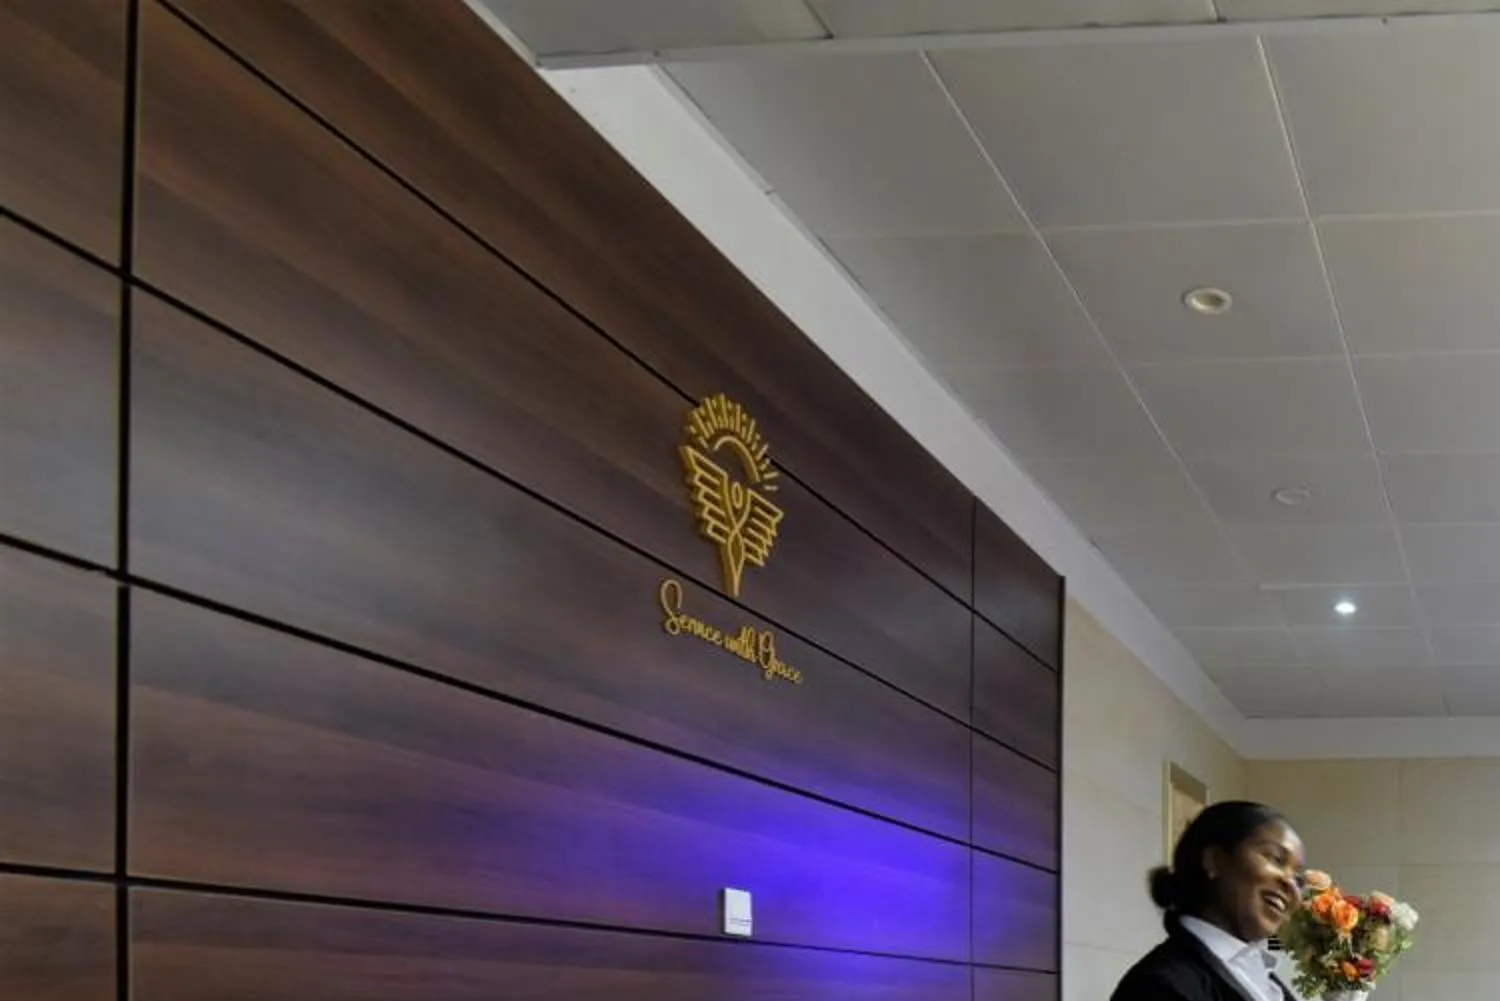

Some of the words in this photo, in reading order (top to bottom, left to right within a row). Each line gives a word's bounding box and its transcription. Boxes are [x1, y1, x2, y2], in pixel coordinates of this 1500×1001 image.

[661, 580, 723, 645] Service
[724, 626, 757, 663] with
[758, 630, 802, 684] Grace
